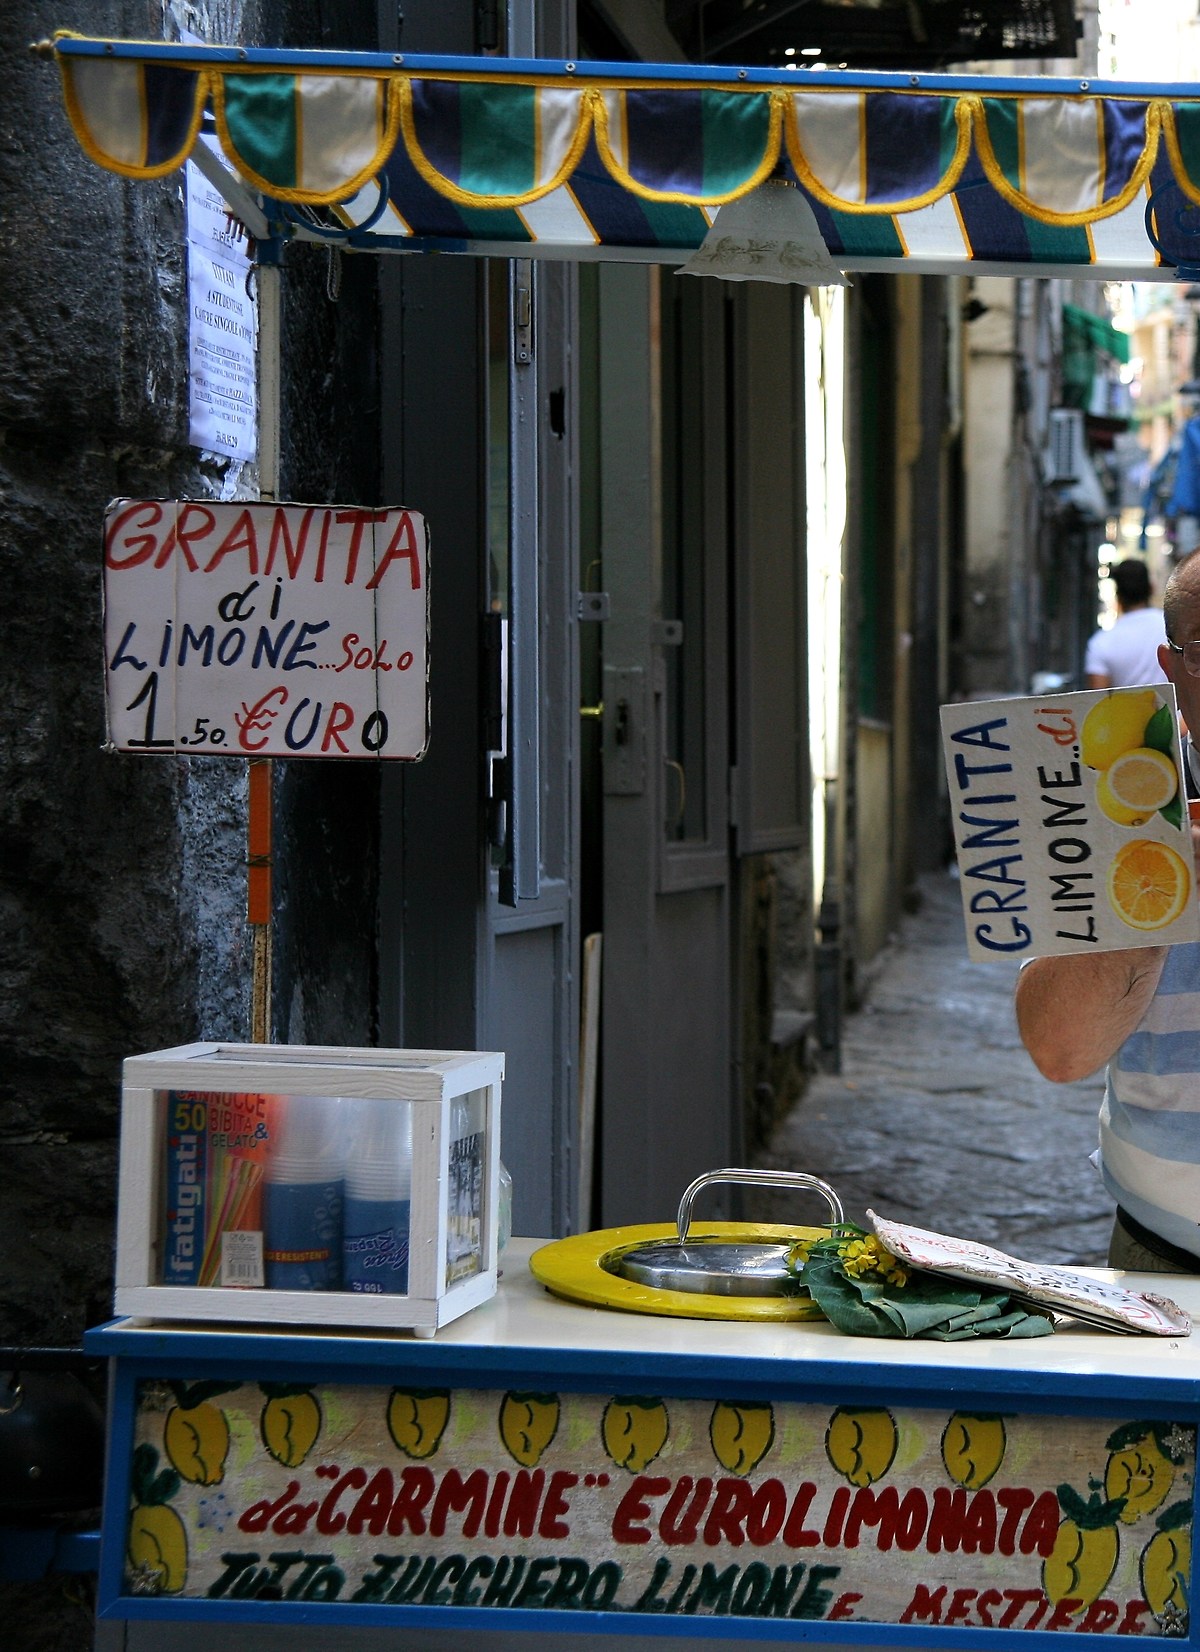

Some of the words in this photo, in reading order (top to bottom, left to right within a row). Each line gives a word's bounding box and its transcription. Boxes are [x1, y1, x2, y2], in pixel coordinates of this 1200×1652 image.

[105, 501, 421, 590] GRANITA
[218, 577, 283, 622] di
[951, 717, 1033, 952] GRANITA
[174, 1103, 207, 1132] 50
[210, 1108, 253, 1132] BIBITA
[254, 1122, 269, 1140] &
[211, 1134, 258, 1149] GELATO
[167, 1134, 202, 1273] fatigati
[611, 1474, 1060, 1560] EUROLIMONATA
[351, 1553, 623, 1610] ZUCCHERO
[634, 1557, 841, 1619] LIMONE
[899, 1584, 1153, 1636] MESTIERE
